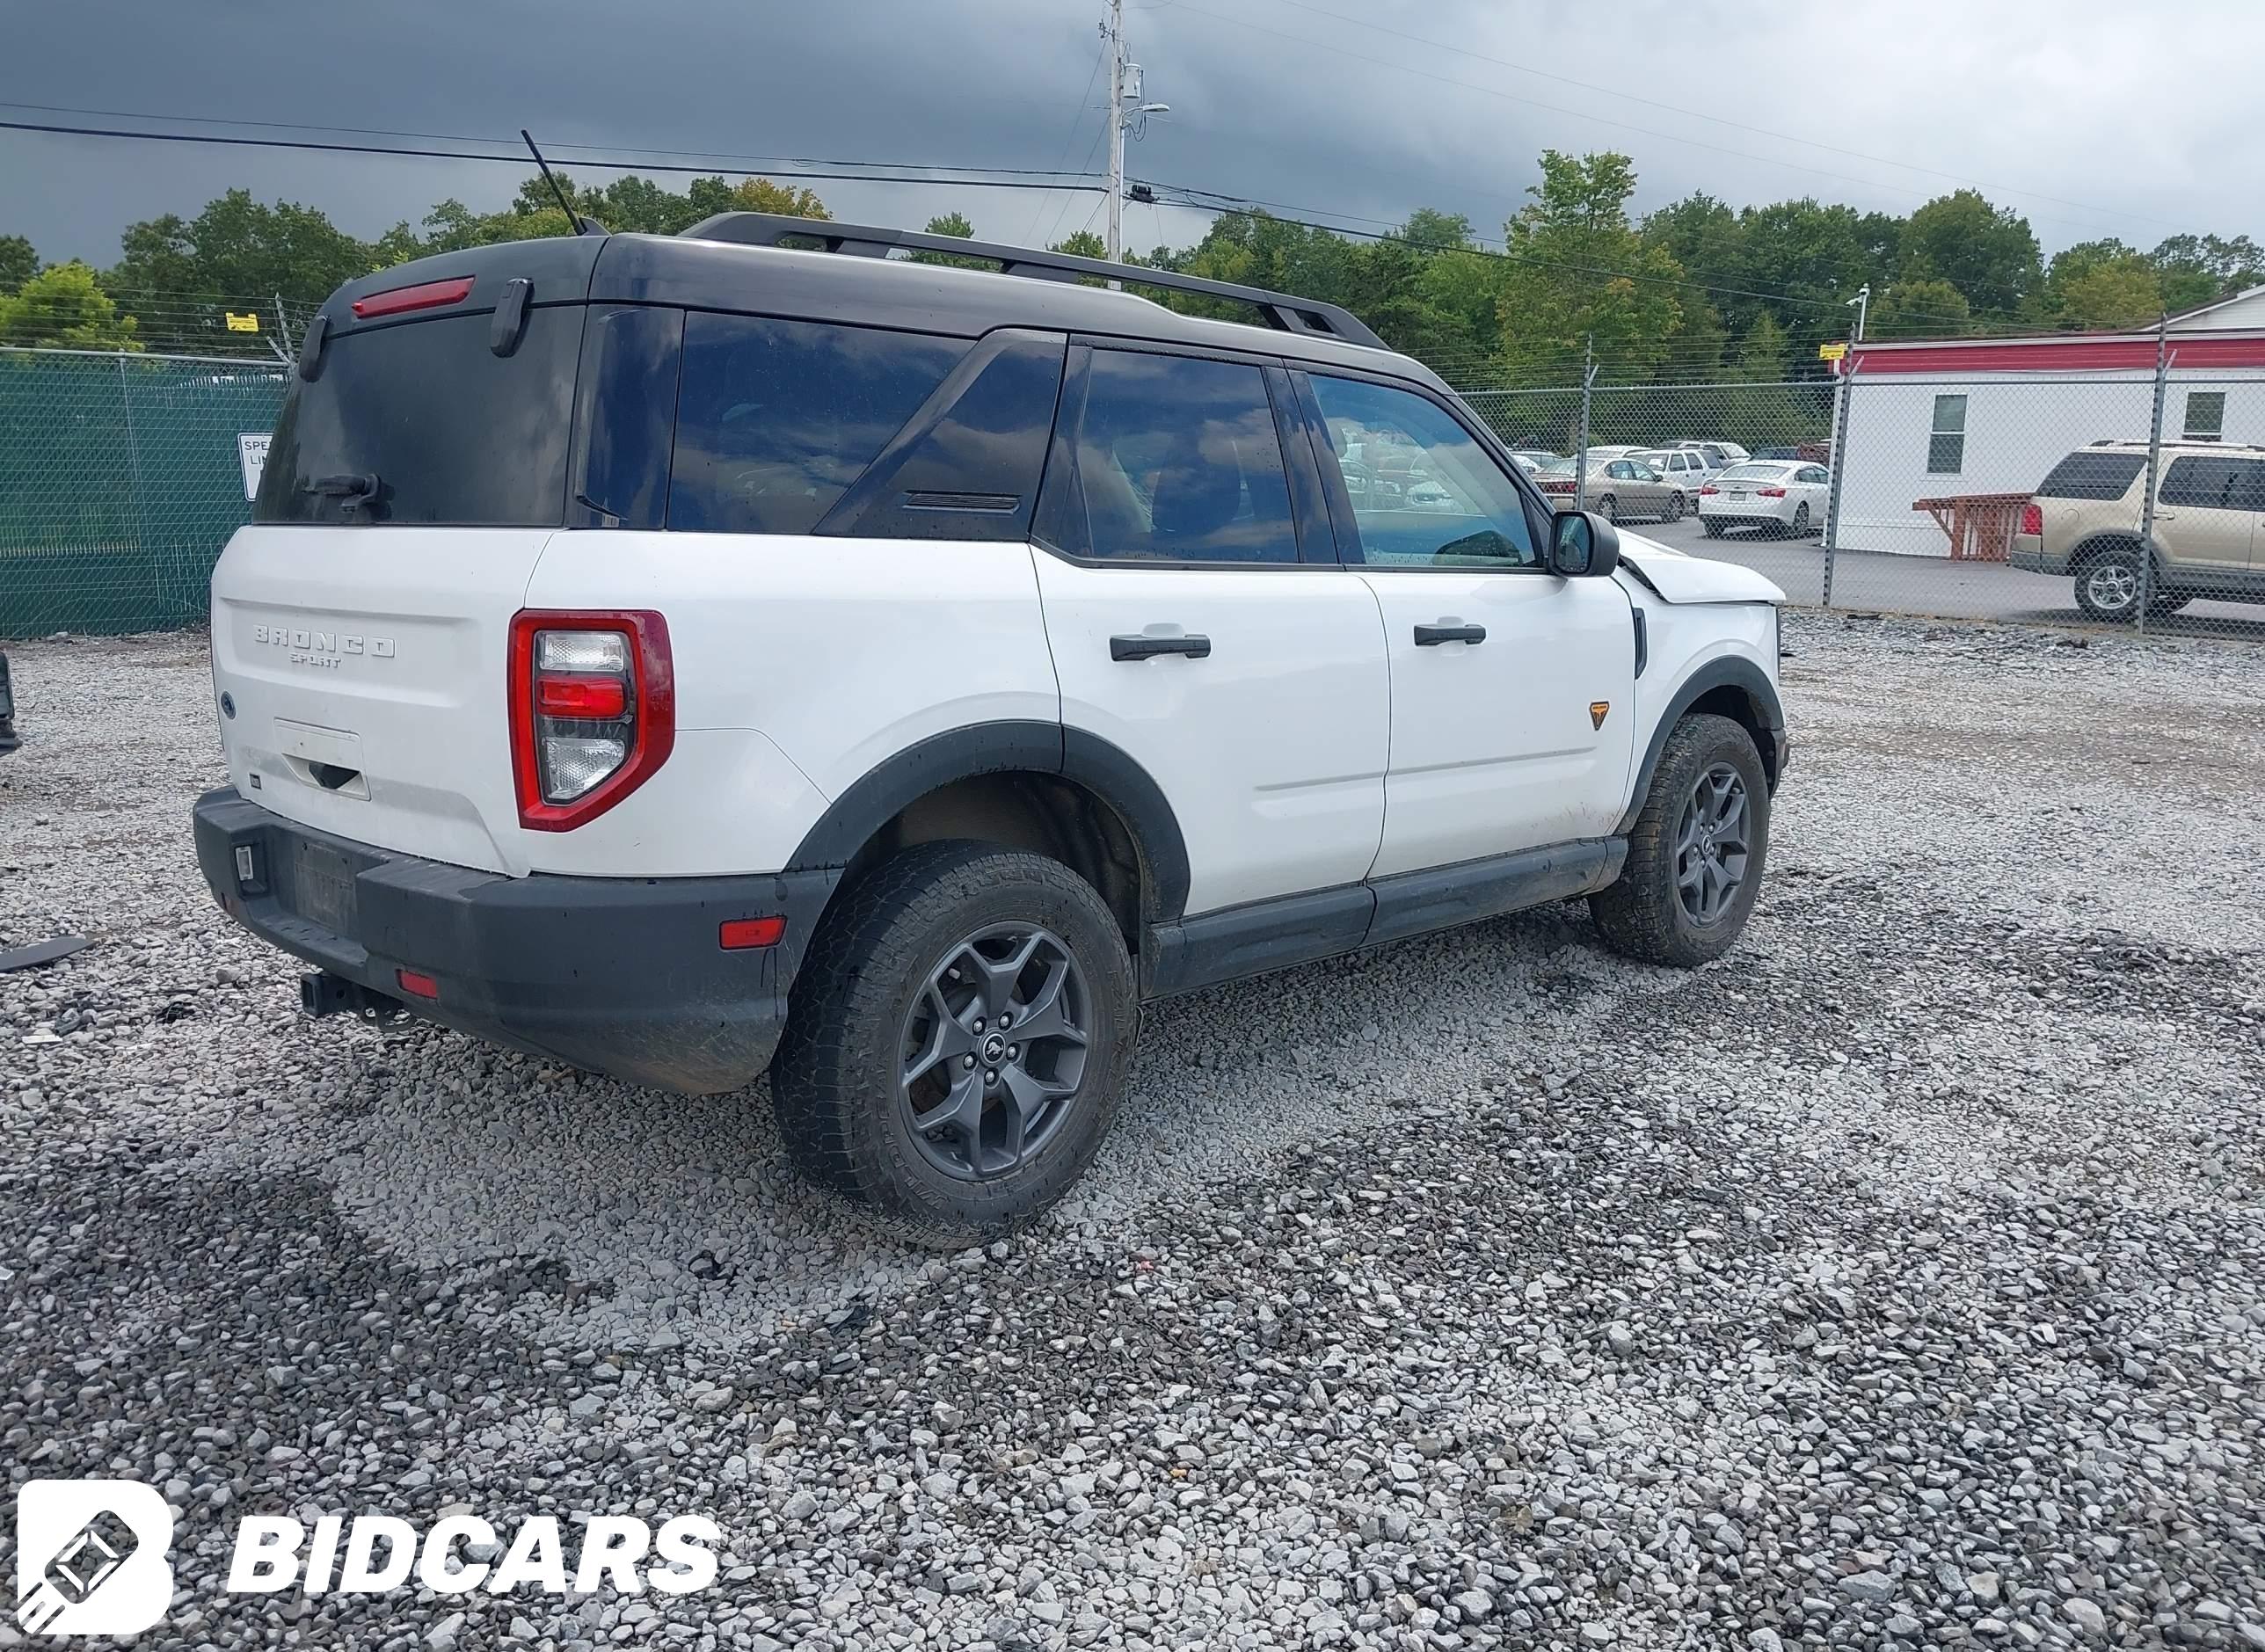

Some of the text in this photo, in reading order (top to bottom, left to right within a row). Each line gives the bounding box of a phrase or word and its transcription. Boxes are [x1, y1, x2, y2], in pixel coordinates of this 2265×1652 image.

[244, 440, 270, 451] SPE
[253, 624, 397, 659] BRONCO
[288, 651, 341, 668] SPORT
